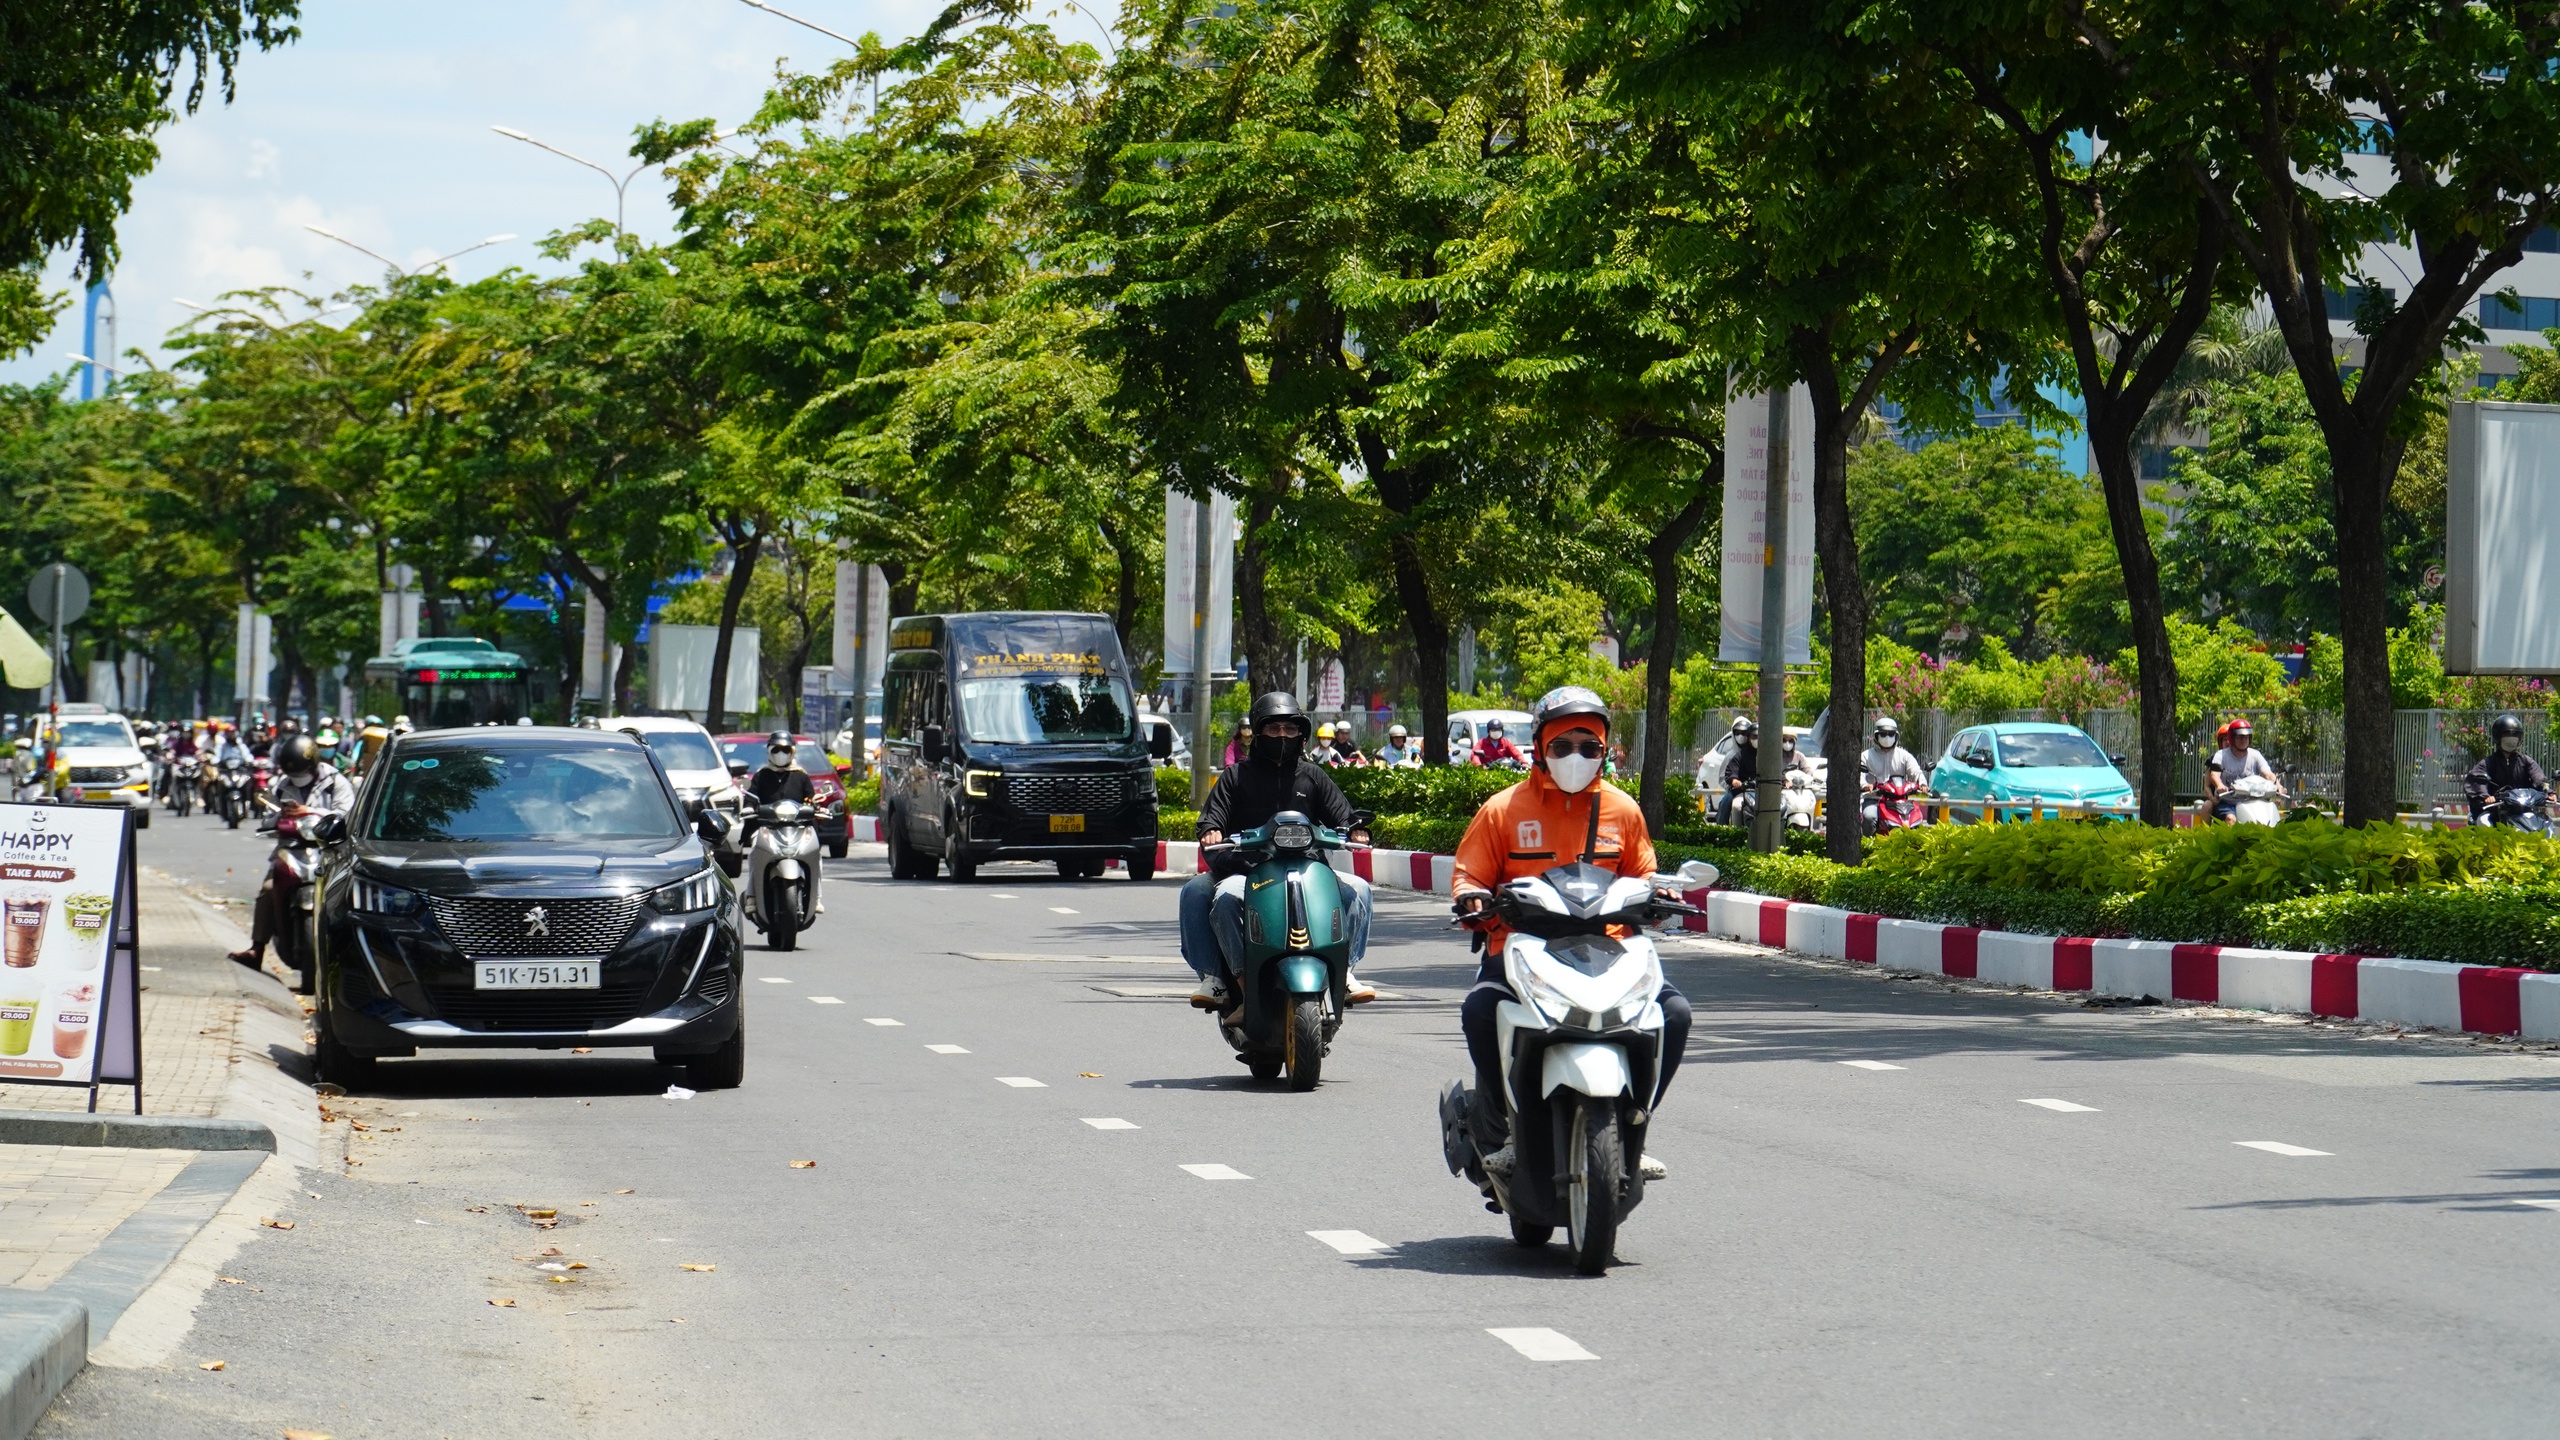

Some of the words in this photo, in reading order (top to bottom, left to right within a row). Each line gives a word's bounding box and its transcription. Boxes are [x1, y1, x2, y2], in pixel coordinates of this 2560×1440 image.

[1, 831, 73, 851] HAPPY
[4, 851, 36, 860] Coffee
[50, 854, 68, 862] Tea
[5, 868, 33, 878] TAKE
[33, 869, 65, 879] AWAY
[14, 917, 39, 925] 19.000
[74, 920, 100, 928] 22.000
[485, 966, 588, 984] 51K-751.31
